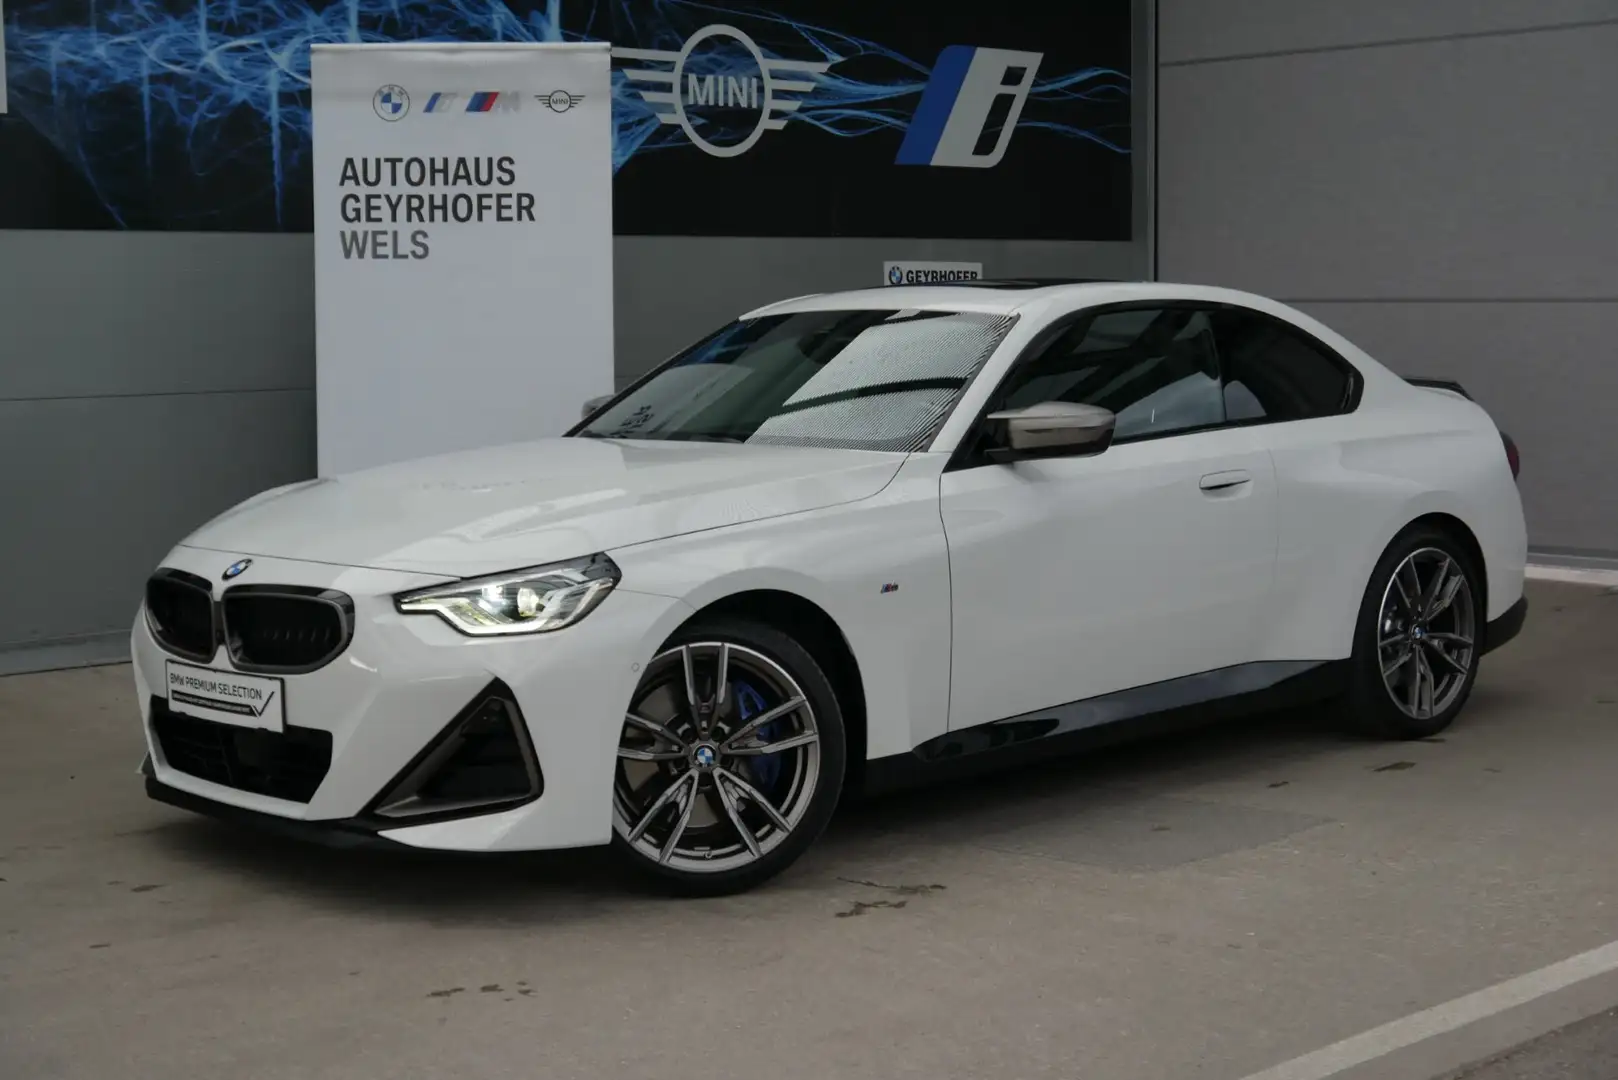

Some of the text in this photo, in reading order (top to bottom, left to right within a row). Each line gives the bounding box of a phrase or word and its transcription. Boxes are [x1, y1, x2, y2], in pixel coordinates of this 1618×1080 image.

[688, 73, 758, 109] MINI
[339, 156, 516, 187] AUTOHAUS
[340, 192, 536, 223] GEYRHOFER
[339, 229, 430, 260] WELS
[906, 269, 978, 283] GEYRHOFER
[170, 673, 262, 700] BMW PREMIUM SELECTION
